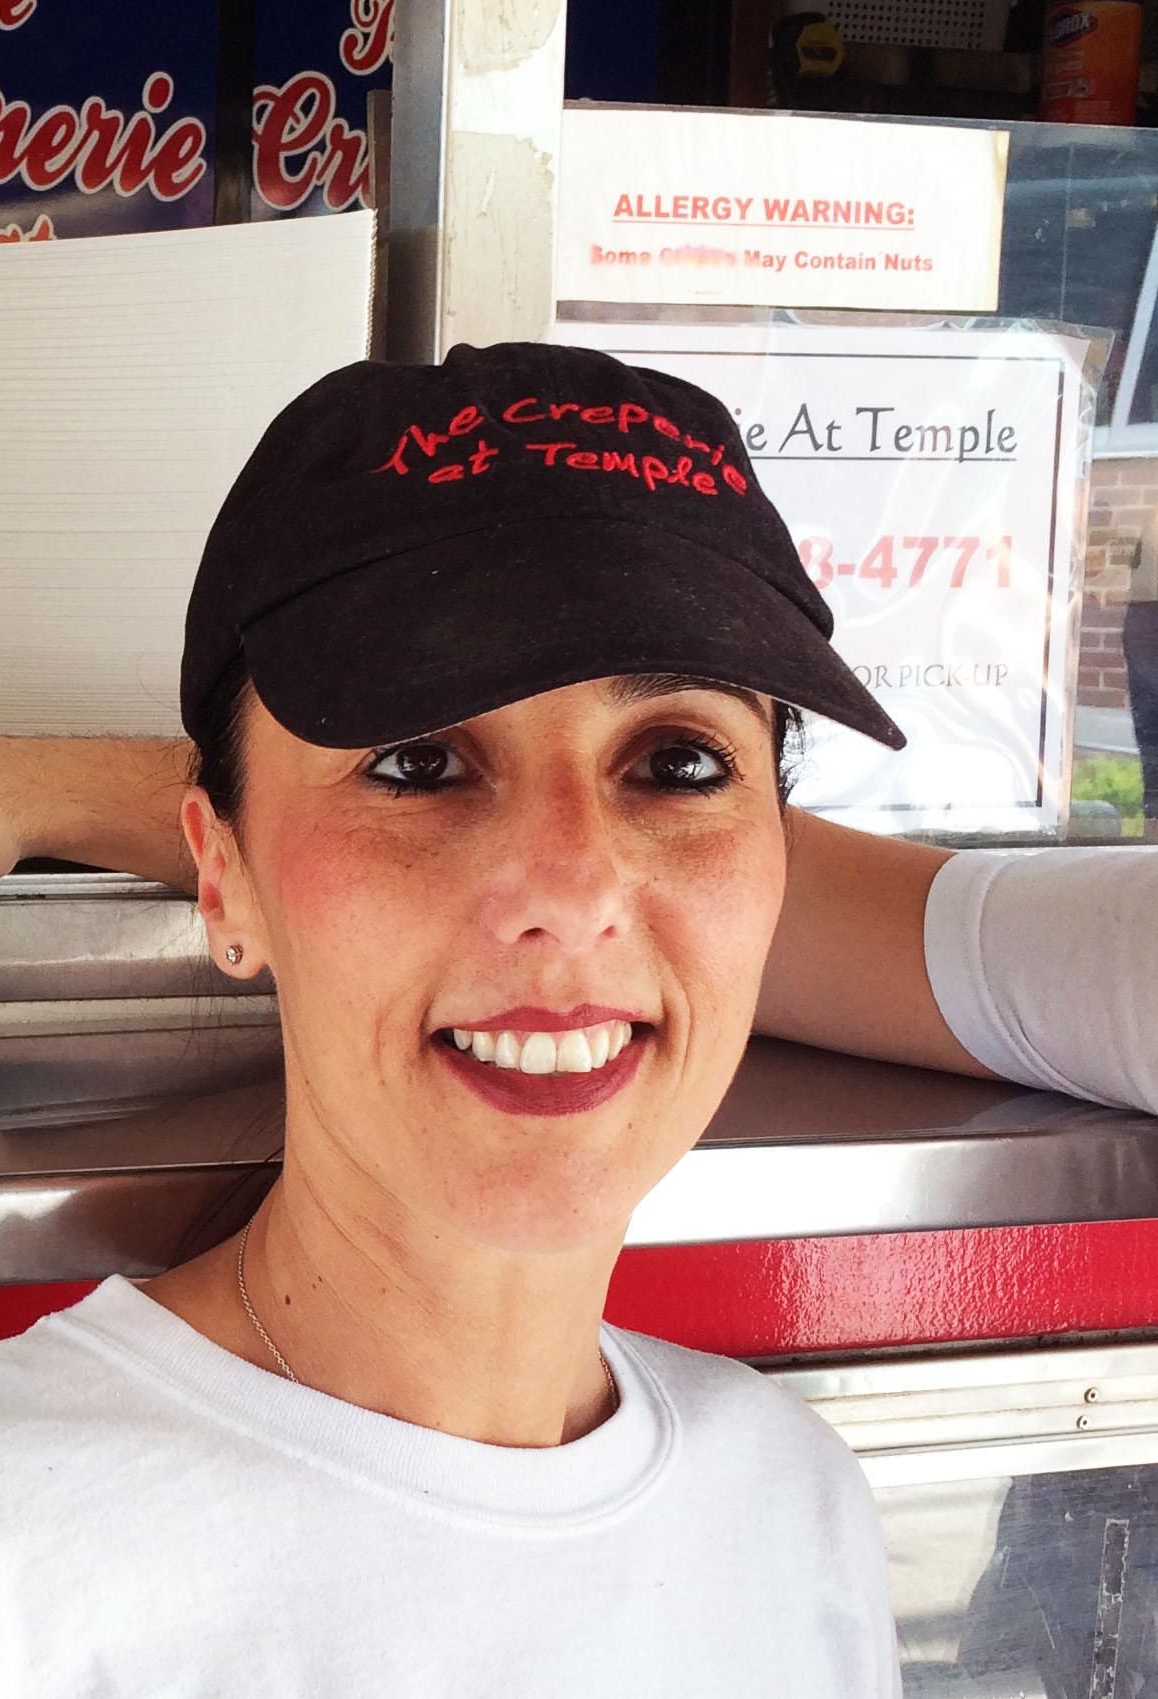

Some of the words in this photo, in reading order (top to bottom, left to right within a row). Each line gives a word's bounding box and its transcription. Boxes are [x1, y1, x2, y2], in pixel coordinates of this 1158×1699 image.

[612, 194, 754, 221] ALLERGY
[763, 198, 915, 226] WARNING:
[744, 249, 787, 273] May
[794, 250, 877, 271] Contain
[884, 253, 934, 272] Nuts
[502, 396, 748, 496] Creperie
[778, 403, 843, 453] At
[856, 406, 1018, 463] Temple
[429, 440, 499, 485] at
[526, 442, 719, 496] Temple
